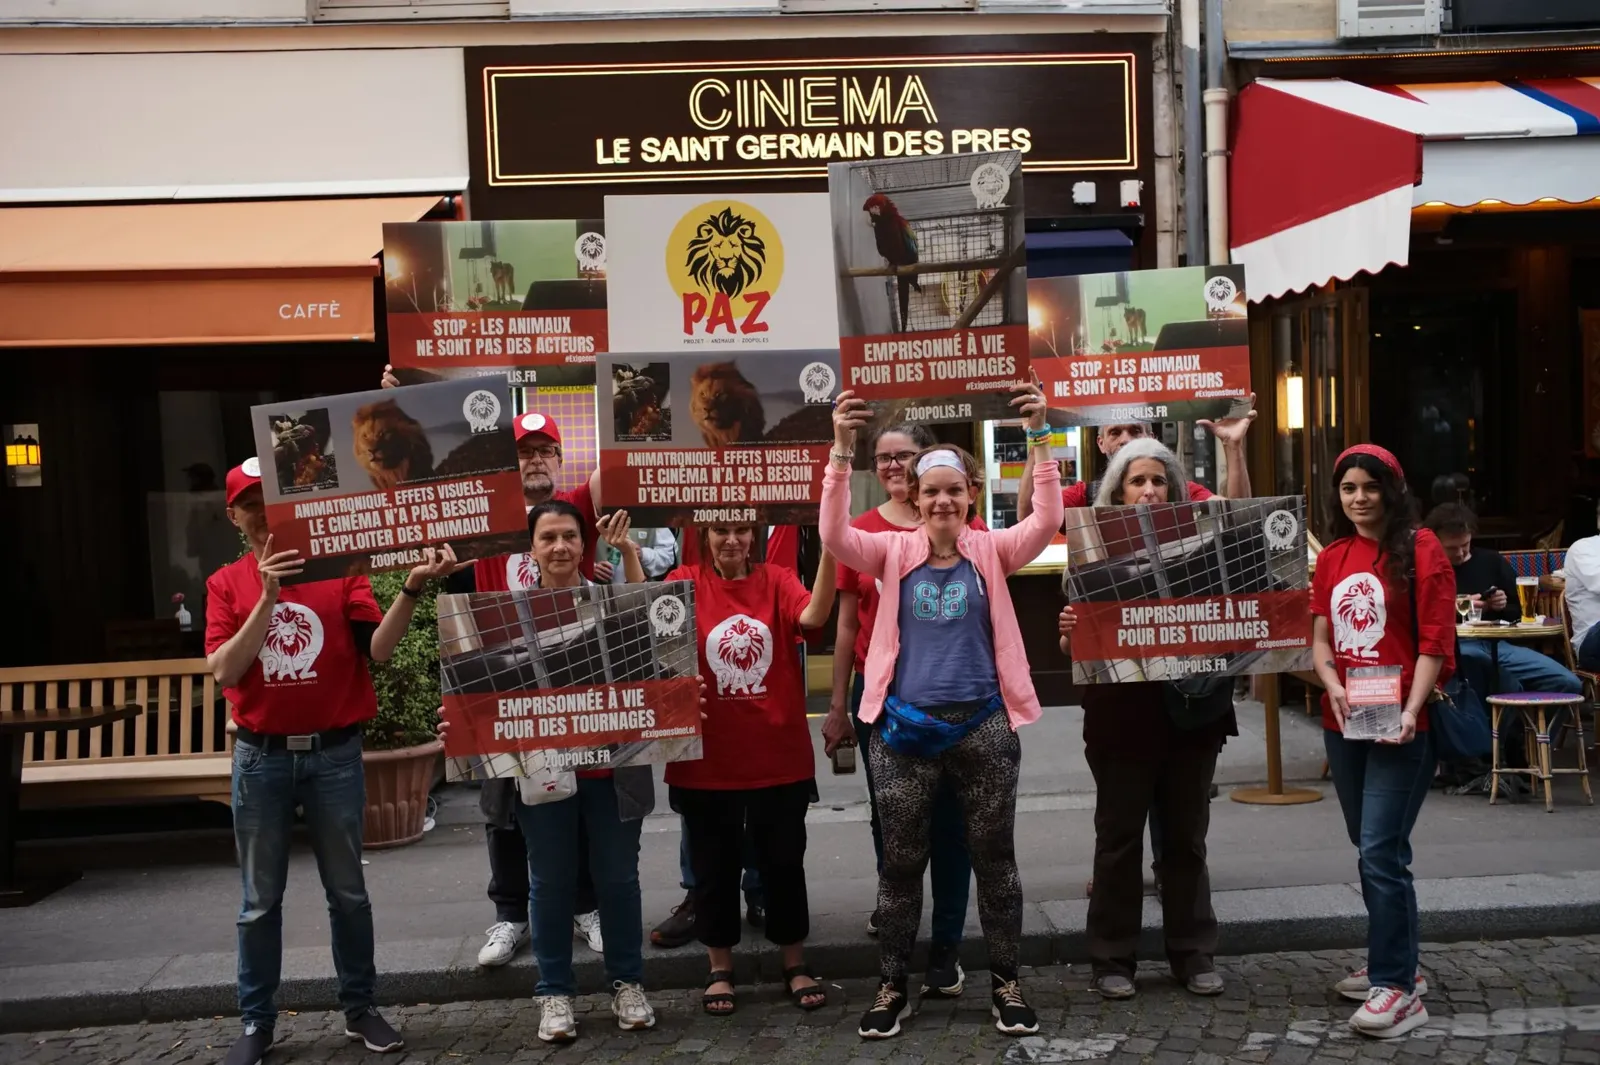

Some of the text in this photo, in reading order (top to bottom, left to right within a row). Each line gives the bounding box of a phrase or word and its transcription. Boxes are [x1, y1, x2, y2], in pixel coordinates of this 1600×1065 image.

[688, 75, 938, 130] CINEMA
[596, 128, 1032, 164] LE SAINT GERMAIN DES PRES
[279, 300, 341, 319] CAFFÈ
[682, 291, 771, 336] PAZ
[433, 318, 467, 336] STOP
[480, 318, 504, 335] LES
[508, 317, 571, 334] ANIMAUX
[416, 336, 595, 357] NE SONT PAS DES ACTEURS
[864, 332, 1006, 363] EMPRISONNÉ À VIE
[851, 356, 1016, 385] POUR DES TOURNAGES
[1070, 362, 1102, 378] STOP
[1114, 359, 1136, 376] LES
[1140, 354, 1201, 374] ANIMAUX
[1054, 372, 1224, 397] NE SONT PAS DES ACTEURS
[905, 403, 972, 421] ZOOPOLIS.FR
[1111, 406, 1168, 420] ZOOPOLIS.FR
[627, 449, 820, 467] ANIMATRONIQUE, EFFETS VISUELS...
[639, 465, 813, 485] LE CINÉMA N'A PAS BESOIN
[294, 480, 495, 519] ANIMATRONIQUE, EFFETS VISUELS...
[638, 484, 810, 503] D'EXPLOITER DES ANIMAUX
[308, 496, 489, 536] LE CINÉMA N'A PAS BESOIN
[693, 509, 756, 522] ZOOPOLIS.FR
[310, 516, 490, 556] D'EXPLOITER DES ANIMAUX
[912, 580, 968, 620] 88
[1121, 597, 1259, 626] EMPRISONNÉE À VIE
[1118, 621, 1269, 647] POUR DES TOURNAGES
[1333, 624, 1385, 658] PAZ
[262, 652, 318, 682] PAZ
[1164, 658, 1227, 675] ZOOPOLIS.FR
[716, 667, 767, 695] PAZ
[498, 686, 645, 718] EMPRISONNÉE À VIE
[494, 709, 655, 740] POUR DES TOURNAGES
[544, 750, 611, 768] ZOOPOLIS.FR
